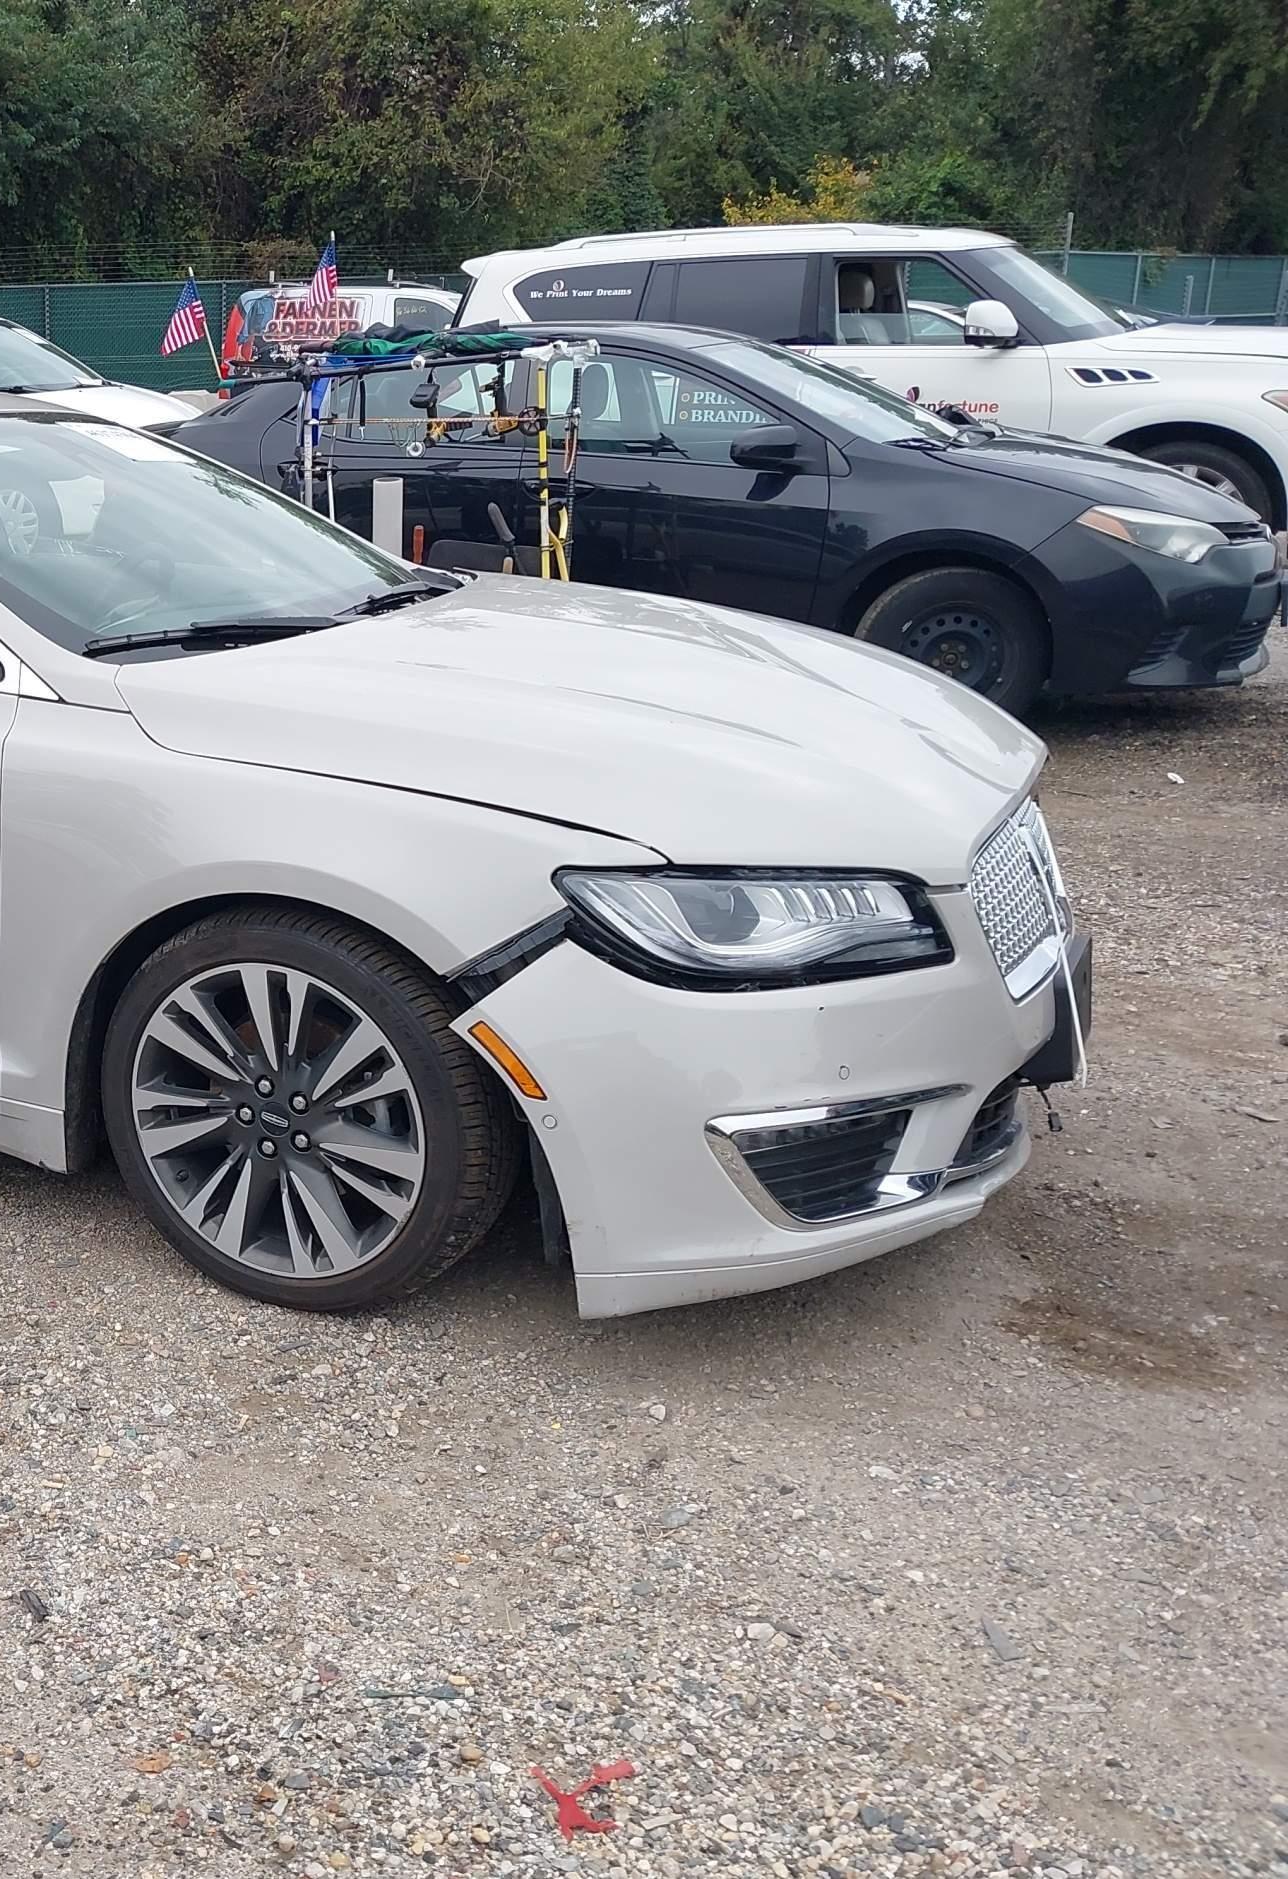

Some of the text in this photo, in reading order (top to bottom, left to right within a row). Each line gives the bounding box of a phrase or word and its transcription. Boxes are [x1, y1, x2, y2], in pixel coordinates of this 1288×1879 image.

[529, 287, 633, 299] We Print Your Dreams
